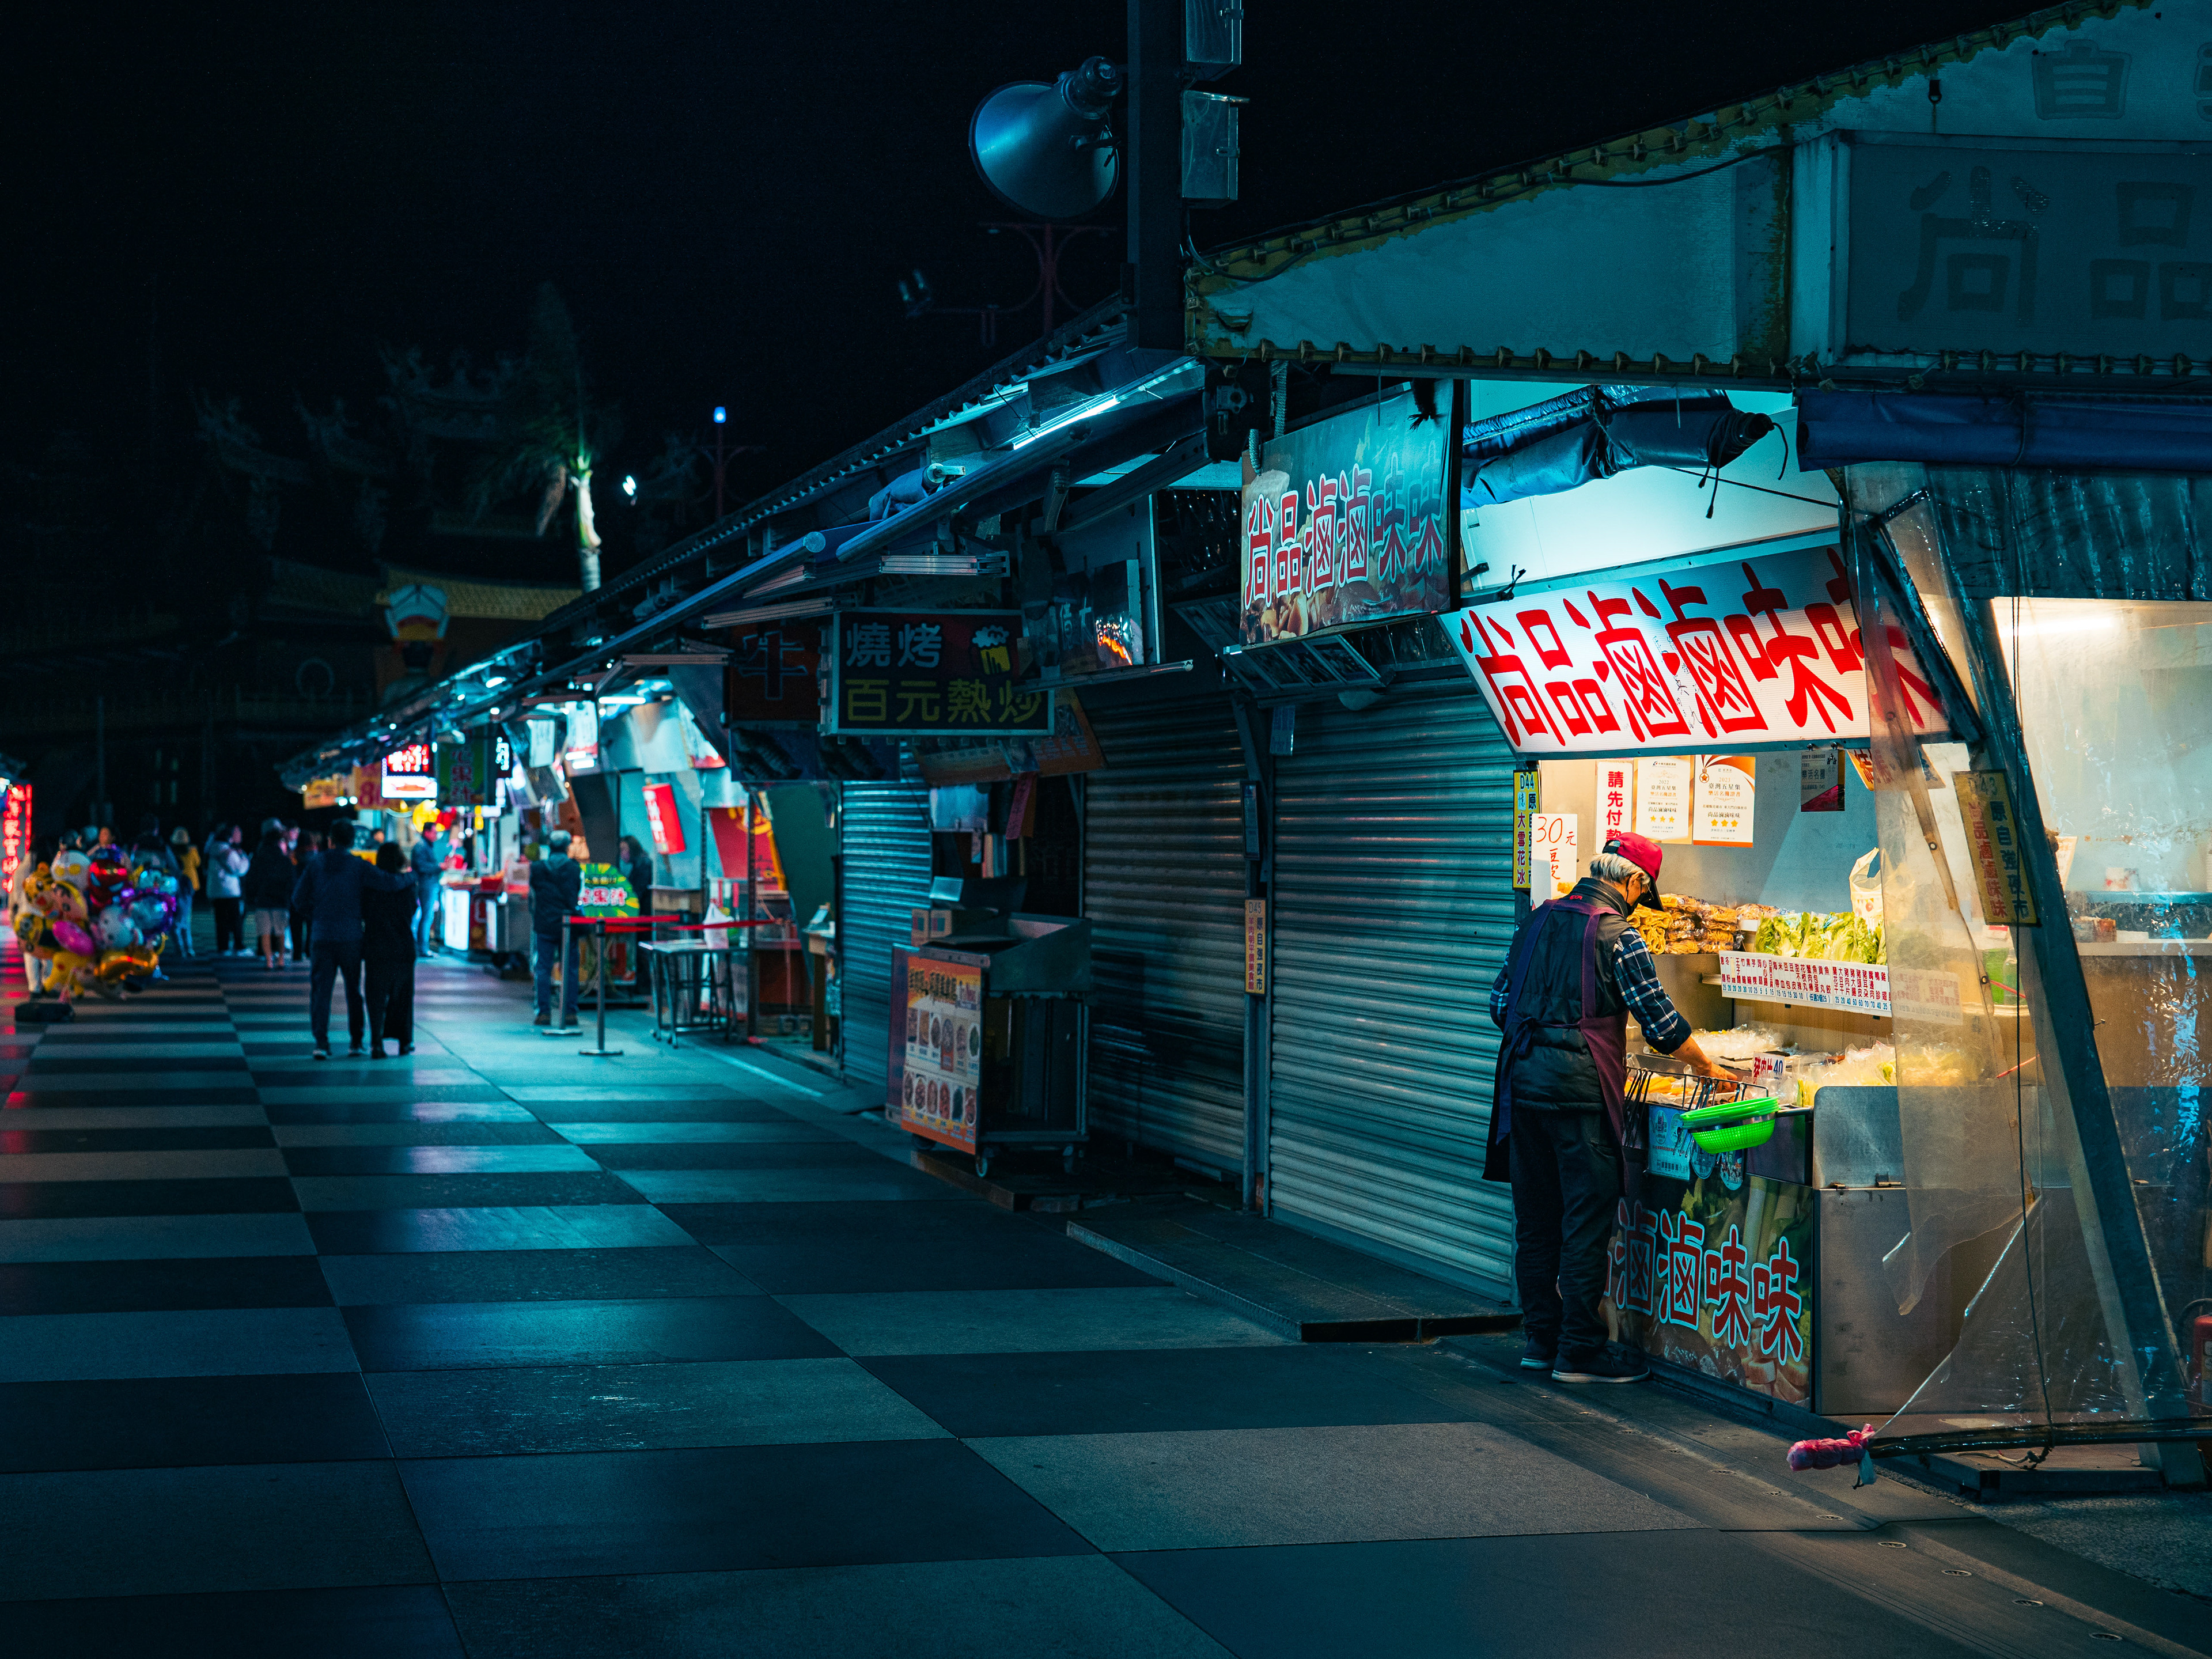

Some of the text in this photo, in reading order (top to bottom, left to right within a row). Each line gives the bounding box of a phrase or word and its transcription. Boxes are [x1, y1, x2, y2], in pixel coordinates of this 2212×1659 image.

[1897, 165, 2212, 327] 尚品
[1244, 440, 1441, 609] 尚品滷滷味味
[738, 630, 809, 701] 牛
[846, 622, 944, 669] 燒烤
[1461, 548, 1941, 747] 尚品滷滷味味
[845, 678, 1043, 724] 百元熱炒
[1520, 774, 1535, 790] D44
[1774, 1059, 1783, 1075] 40
[1604, 1196, 1803, 1366] 滷滷味味
